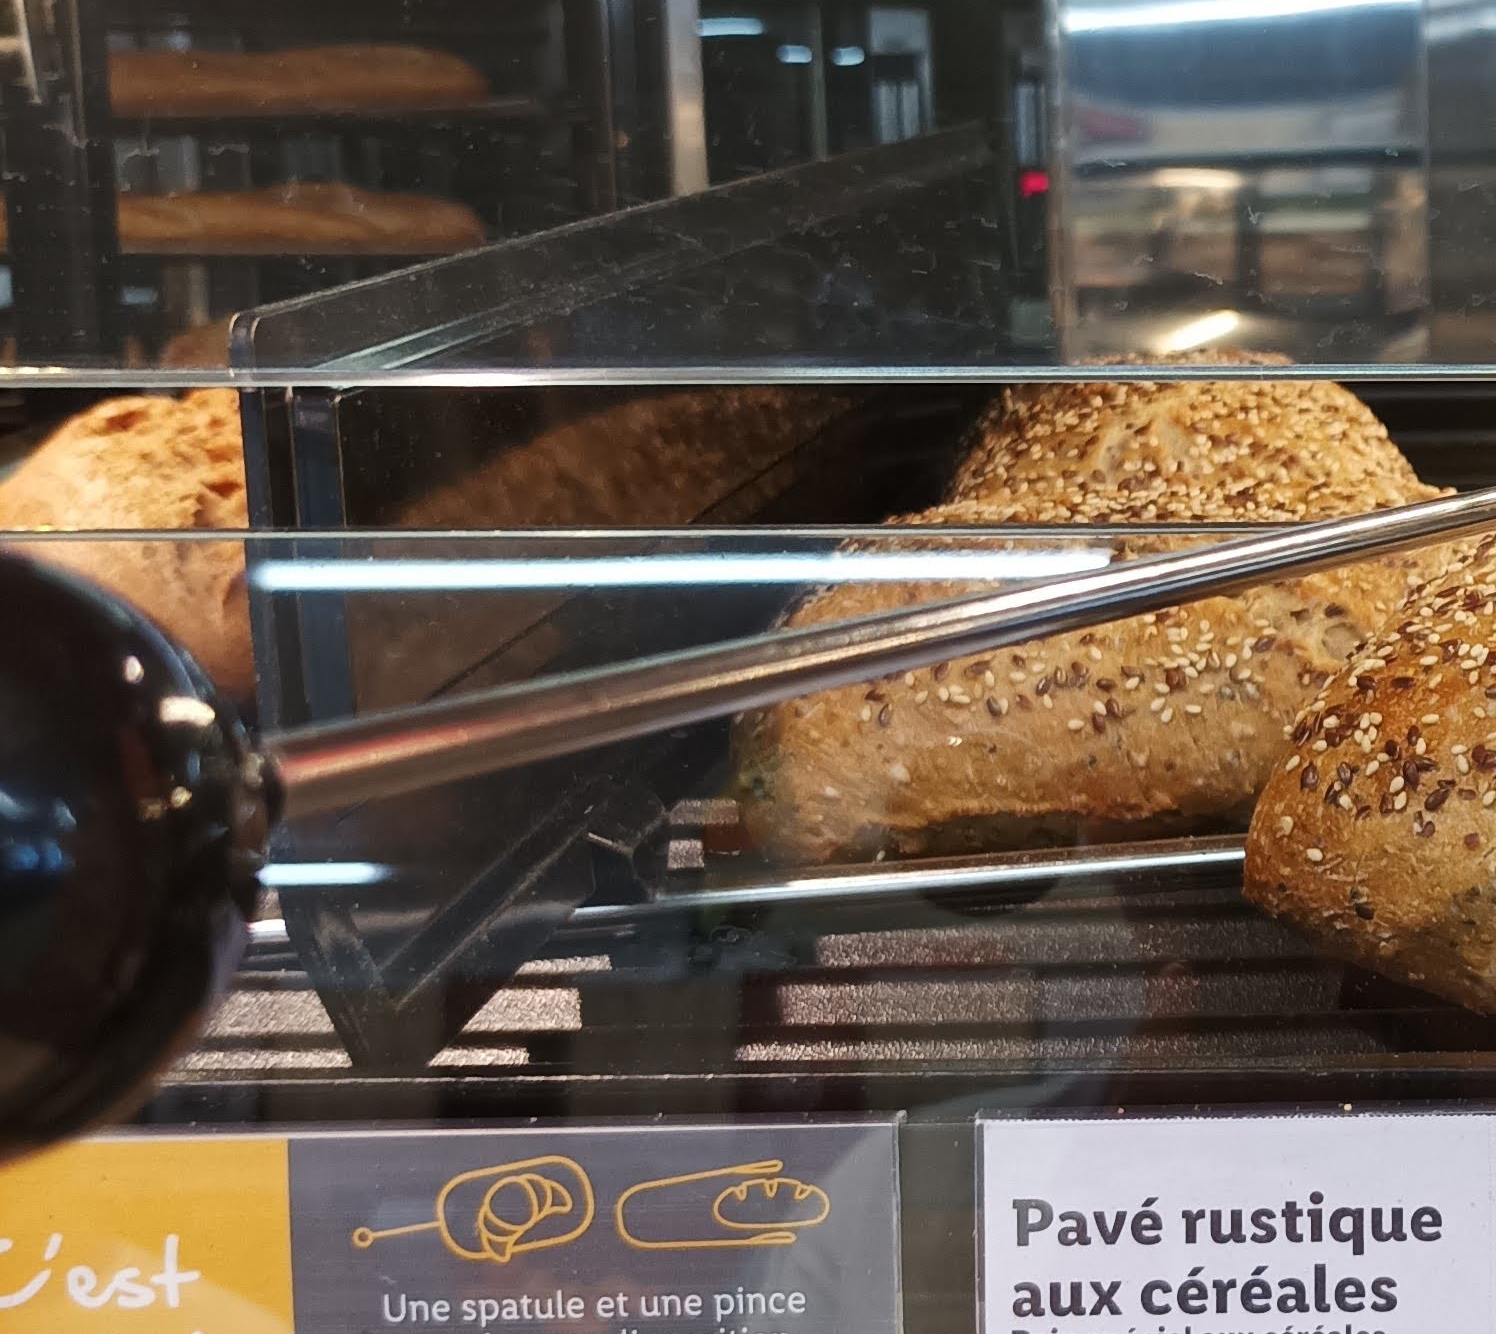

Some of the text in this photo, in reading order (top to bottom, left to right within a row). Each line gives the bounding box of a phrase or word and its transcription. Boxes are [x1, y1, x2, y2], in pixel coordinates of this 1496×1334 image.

[1012, 1191, 1443, 1256] Pavé rustique
[382, 1286, 806, 1328] Une spatule et une pince
[1012, 1263, 1398, 1318] aux céréales
